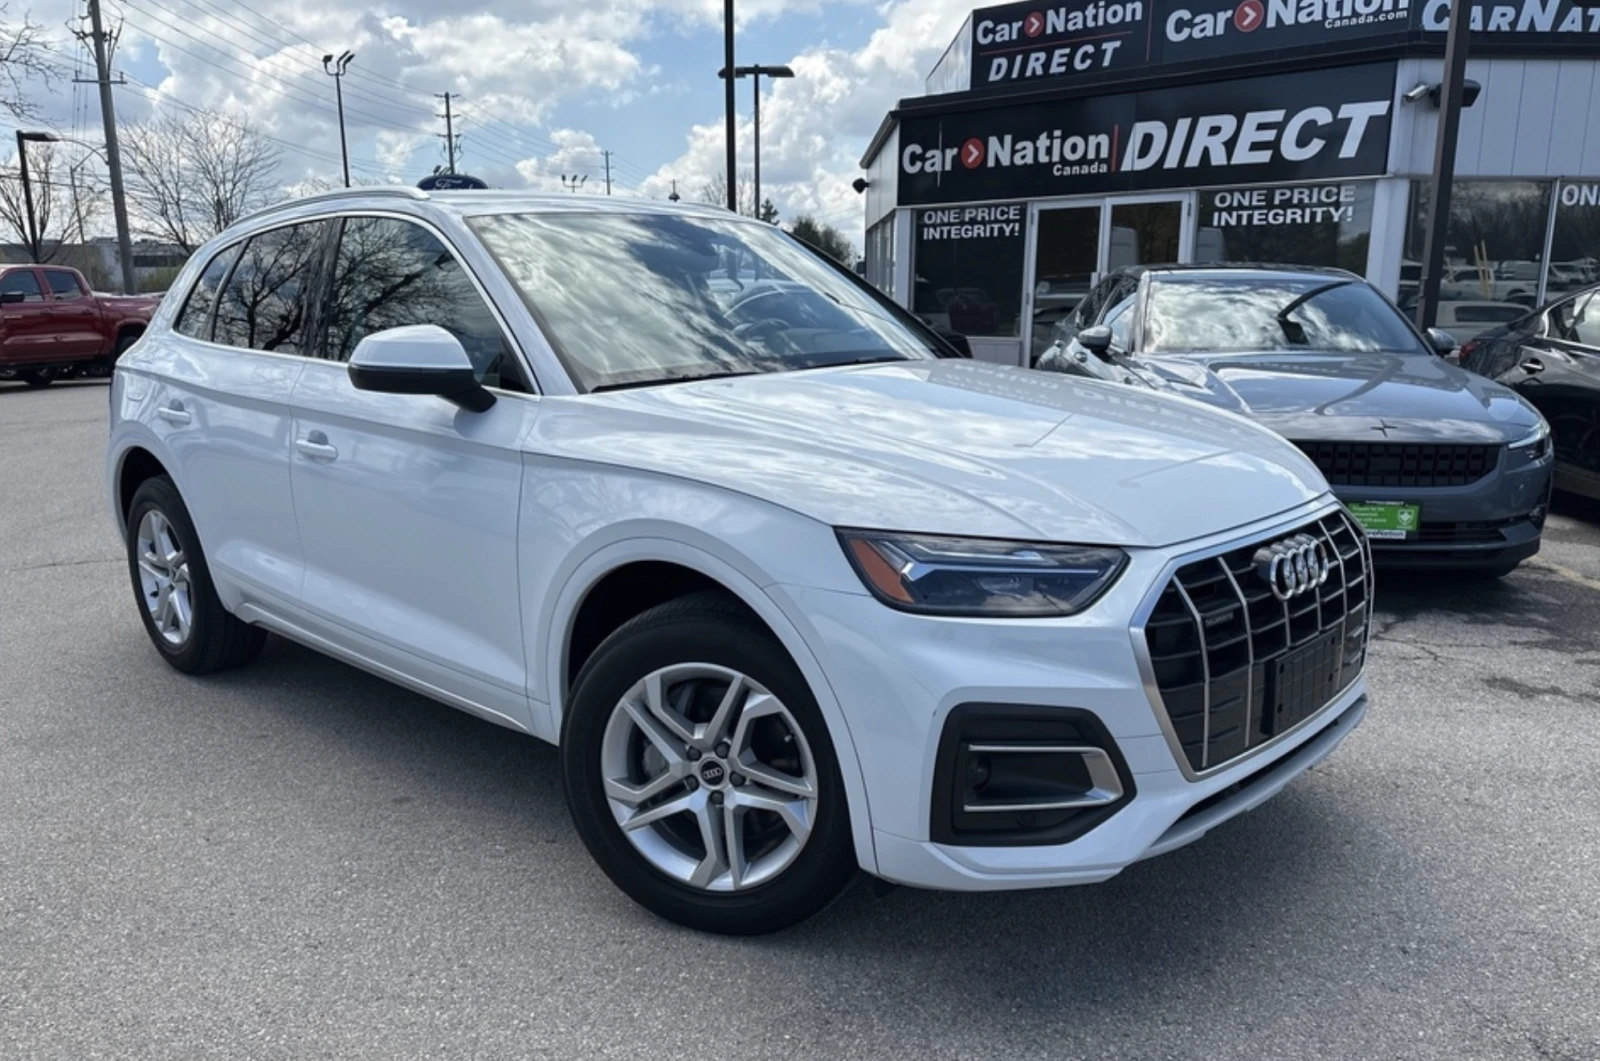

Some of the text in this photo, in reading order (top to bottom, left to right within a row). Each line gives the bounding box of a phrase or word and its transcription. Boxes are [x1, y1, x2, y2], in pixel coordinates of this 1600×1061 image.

[976, 1, 1143, 45] Car Nation
[1165, 9, 1232, 42] Car
[1324, 10, 1408, 29] Canada.com
[988, 40, 1122, 82] DIRECT
[1120, 100, 1391, 172] DIRECT
[902, 129, 1110, 174] Car Nation
[1052, 161, 1108, 176] Canada
[1213, 185, 1357, 208] ONE PRICE
[1562, 184, 1600, 206] ON
[923, 205, 1021, 225] ONE PRICE
[1212, 205, 1355, 227] INTEGRITY!
[923, 222, 1020, 240] INTEGRITY!
